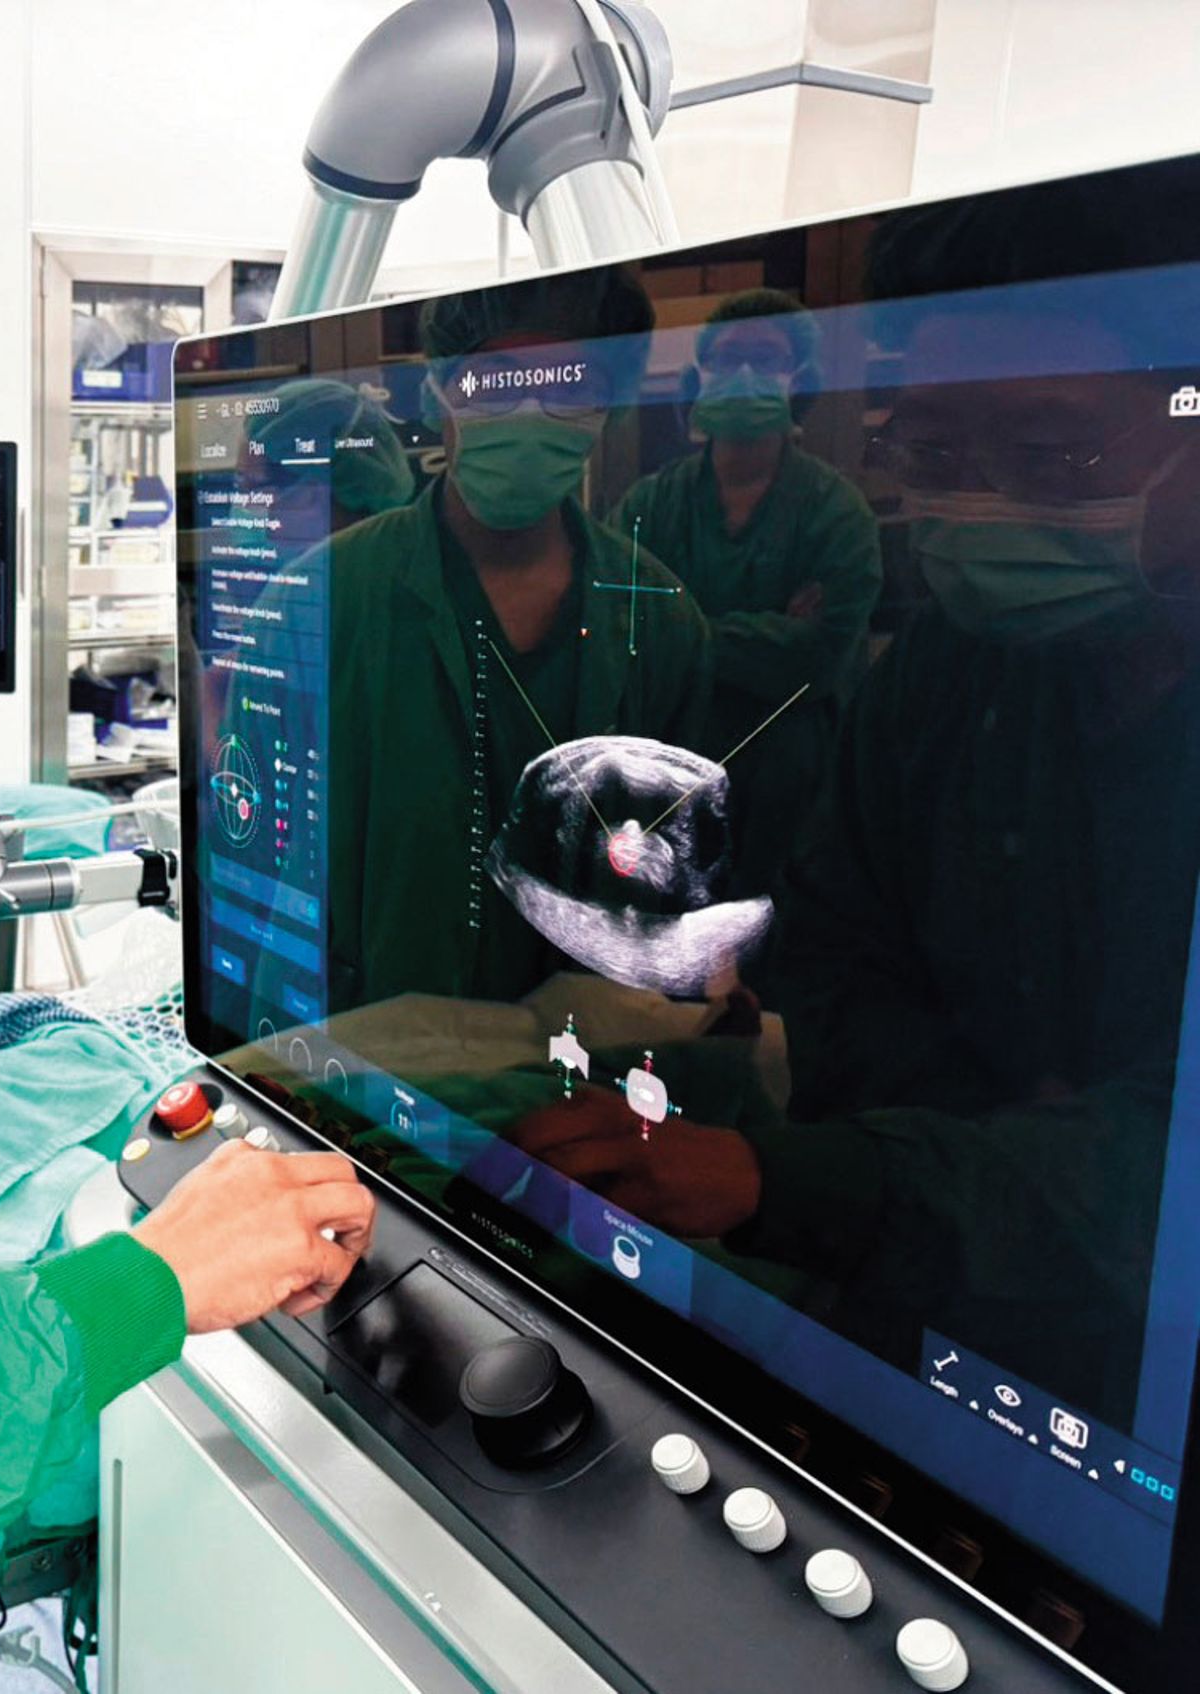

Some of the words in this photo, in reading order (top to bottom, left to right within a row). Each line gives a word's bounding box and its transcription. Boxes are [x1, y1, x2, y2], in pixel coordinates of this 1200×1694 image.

[481, 364, 582, 390] HISTOSONICS
[249, 439, 265, 456] Plan
[250, 490, 275, 508] Settings
[986, 1407, 1025, 1438] Overlays
[1049, 1444, 1082, 1470] Screen
